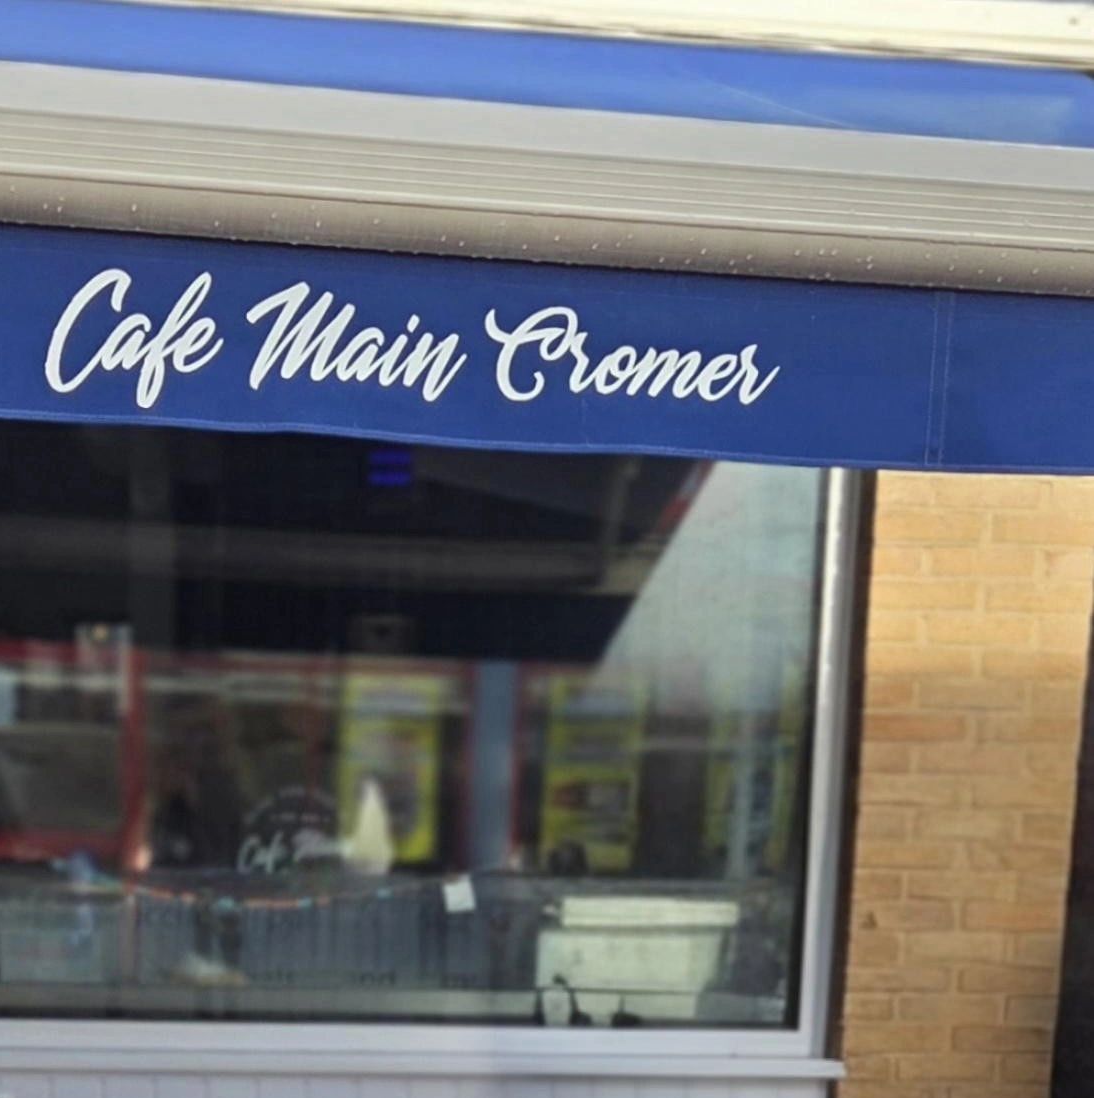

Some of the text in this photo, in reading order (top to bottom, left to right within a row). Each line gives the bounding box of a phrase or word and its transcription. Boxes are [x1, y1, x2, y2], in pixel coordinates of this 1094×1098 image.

[44, 268, 781, 409] Cafe Main Cromer
